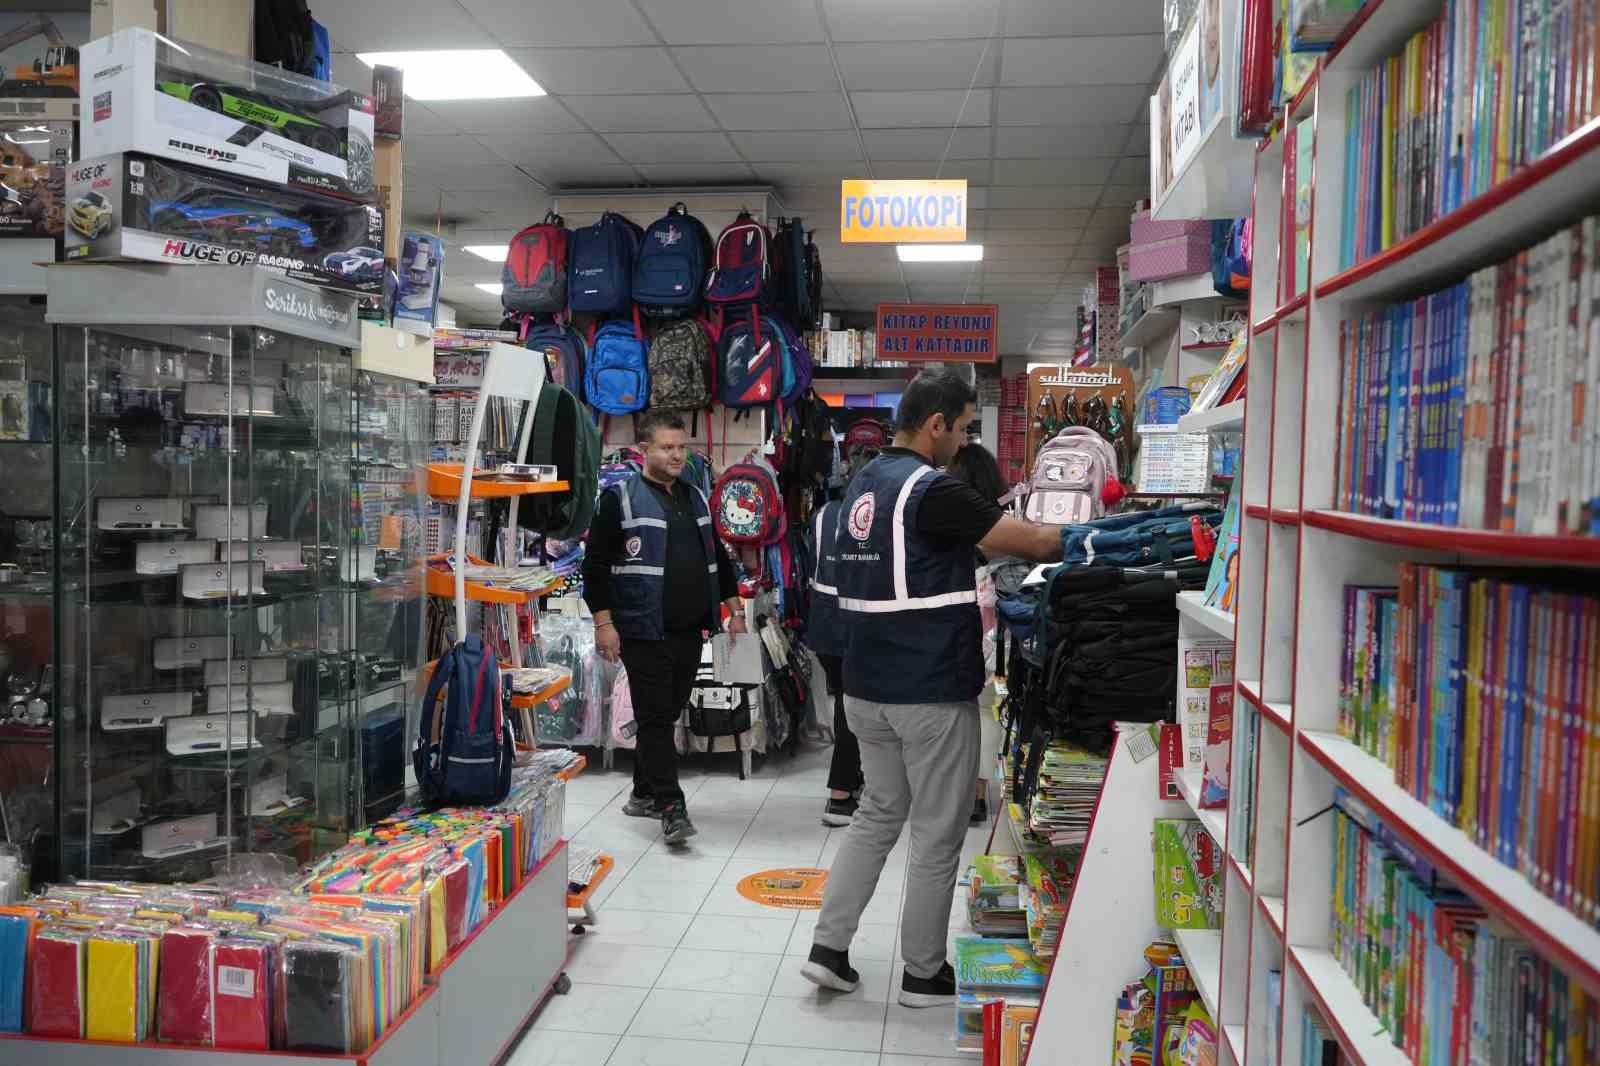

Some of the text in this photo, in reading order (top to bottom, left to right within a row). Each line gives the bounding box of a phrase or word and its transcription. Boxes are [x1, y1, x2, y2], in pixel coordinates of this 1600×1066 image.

[168, 139, 237, 161] RACING
[162, 239, 225, 263] HUGE
[226, 249, 256, 267] OF
[258, 254, 305, 270] RACING
[934, 314, 992, 330] REYONU
[884, 336, 989, 353] ALT KATTADIR
